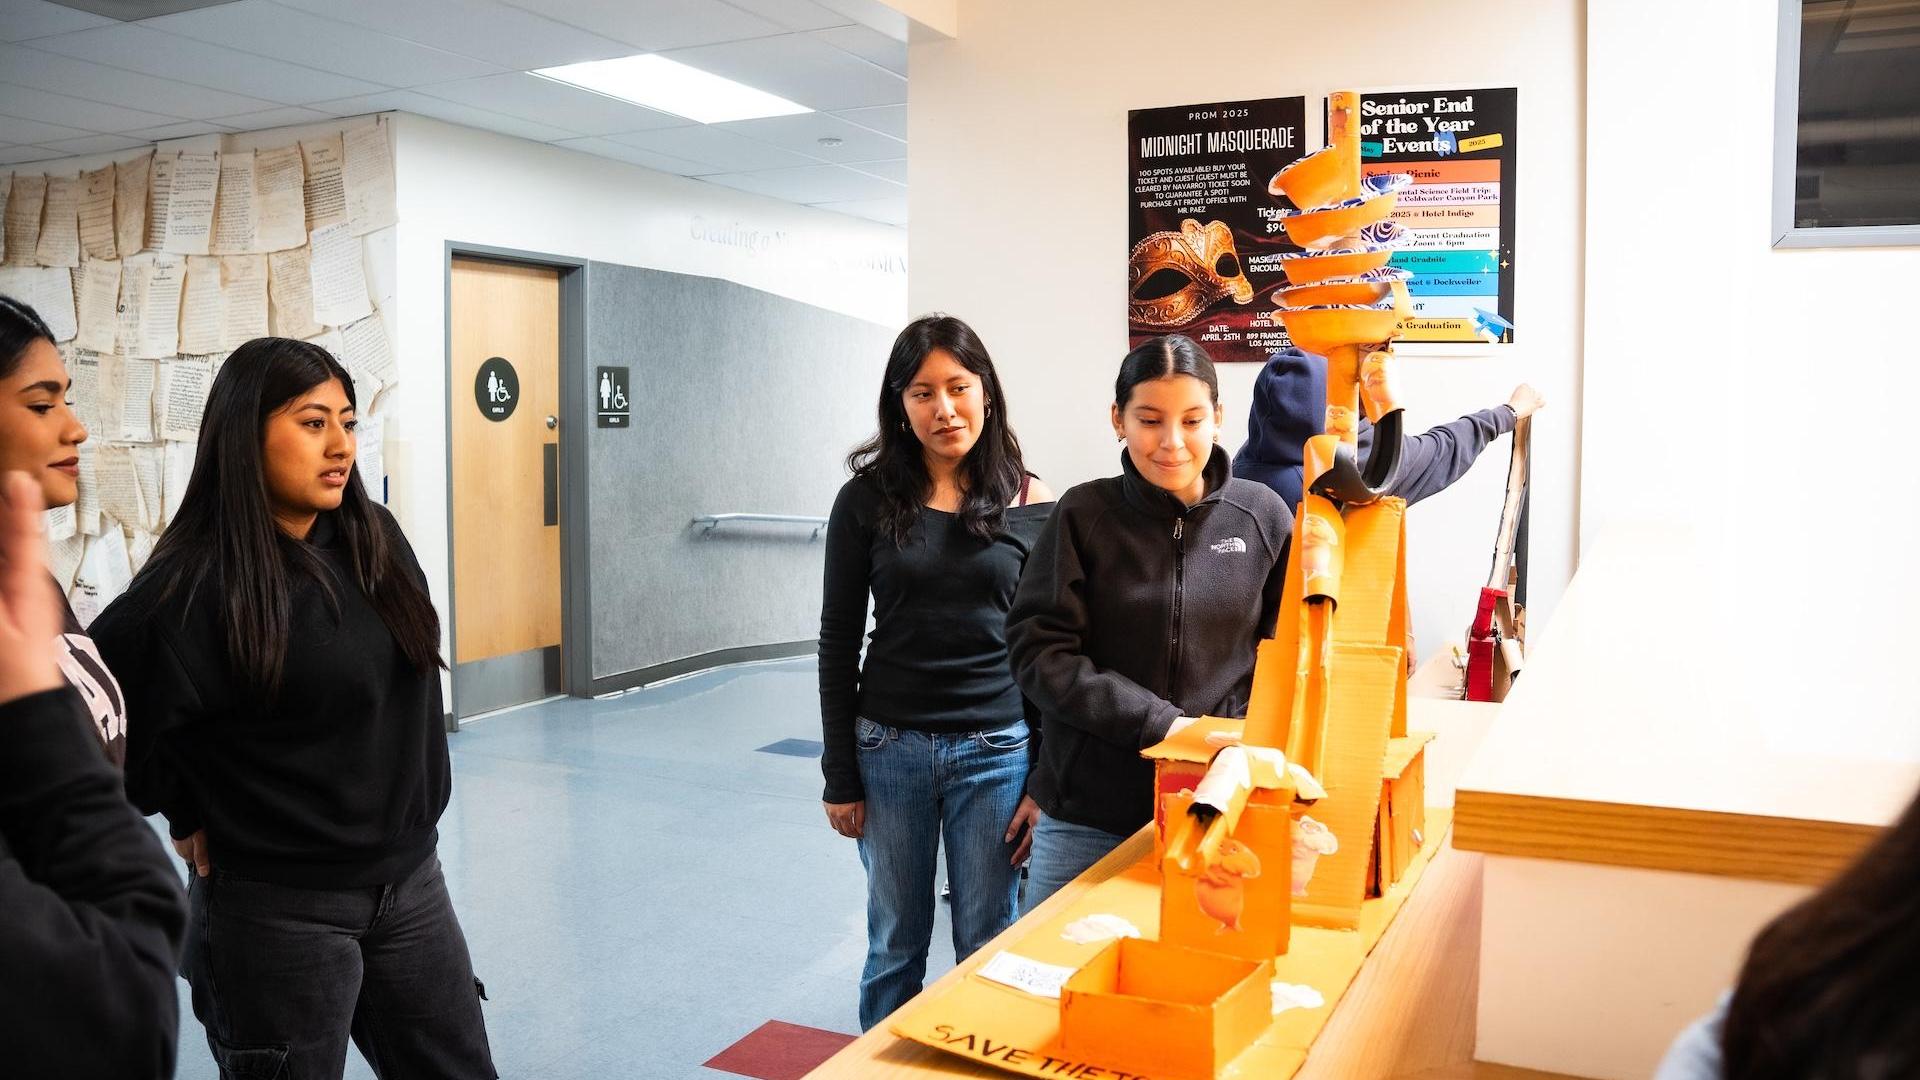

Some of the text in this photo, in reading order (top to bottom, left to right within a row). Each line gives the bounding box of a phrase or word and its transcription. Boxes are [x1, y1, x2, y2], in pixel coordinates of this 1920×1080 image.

[1361, 96, 1474, 116] Senior End
[1188, 109, 1249, 121] PROM 2025
[1361, 116, 1475, 135] of the Year
[1141, 126, 1295, 158] MIDNIGHT MASQUERADE
[1382, 137, 1451, 154] Events
[1468, 139, 1486, 148] 2025
[1152, 168, 1174, 176] SPOTS
[1137, 177, 1158, 185] TICKET
[1174, 174, 1195, 182] GUEST
[1196, 172, 1218, 182] (GUEST
[1134, 185, 1162, 193] CLEARED
[1172, 182, 1206, 190] NAVARRO)
[1208, 180, 1230, 188] TICKET
[1230, 179, 1250, 187] SOON
[1165, 190, 1202, 199] GUARANTEE
[1140, 200, 1172, 208] PURCHASE
[1183, 197, 1204, 206] FRONT
[1205, 196, 1228, 204] OFFICE
[1229, 195, 1247, 203] WITH
[1190, 206, 1206, 214] PAEZ
[1447, 209, 1474, 218] Indigo
[1442, 231, 1490, 239] Graduation
[1250, 264, 1285, 272] ENCOURA
[1434, 278, 1482, 286] Dockweiler
[1209, 324, 1230, 332] DATE:
[1406, 321, 1461, 329] Graduation
[1222, 332, 1240, 340] 25TH
[928, 1025, 1034, 1065] SAVE
